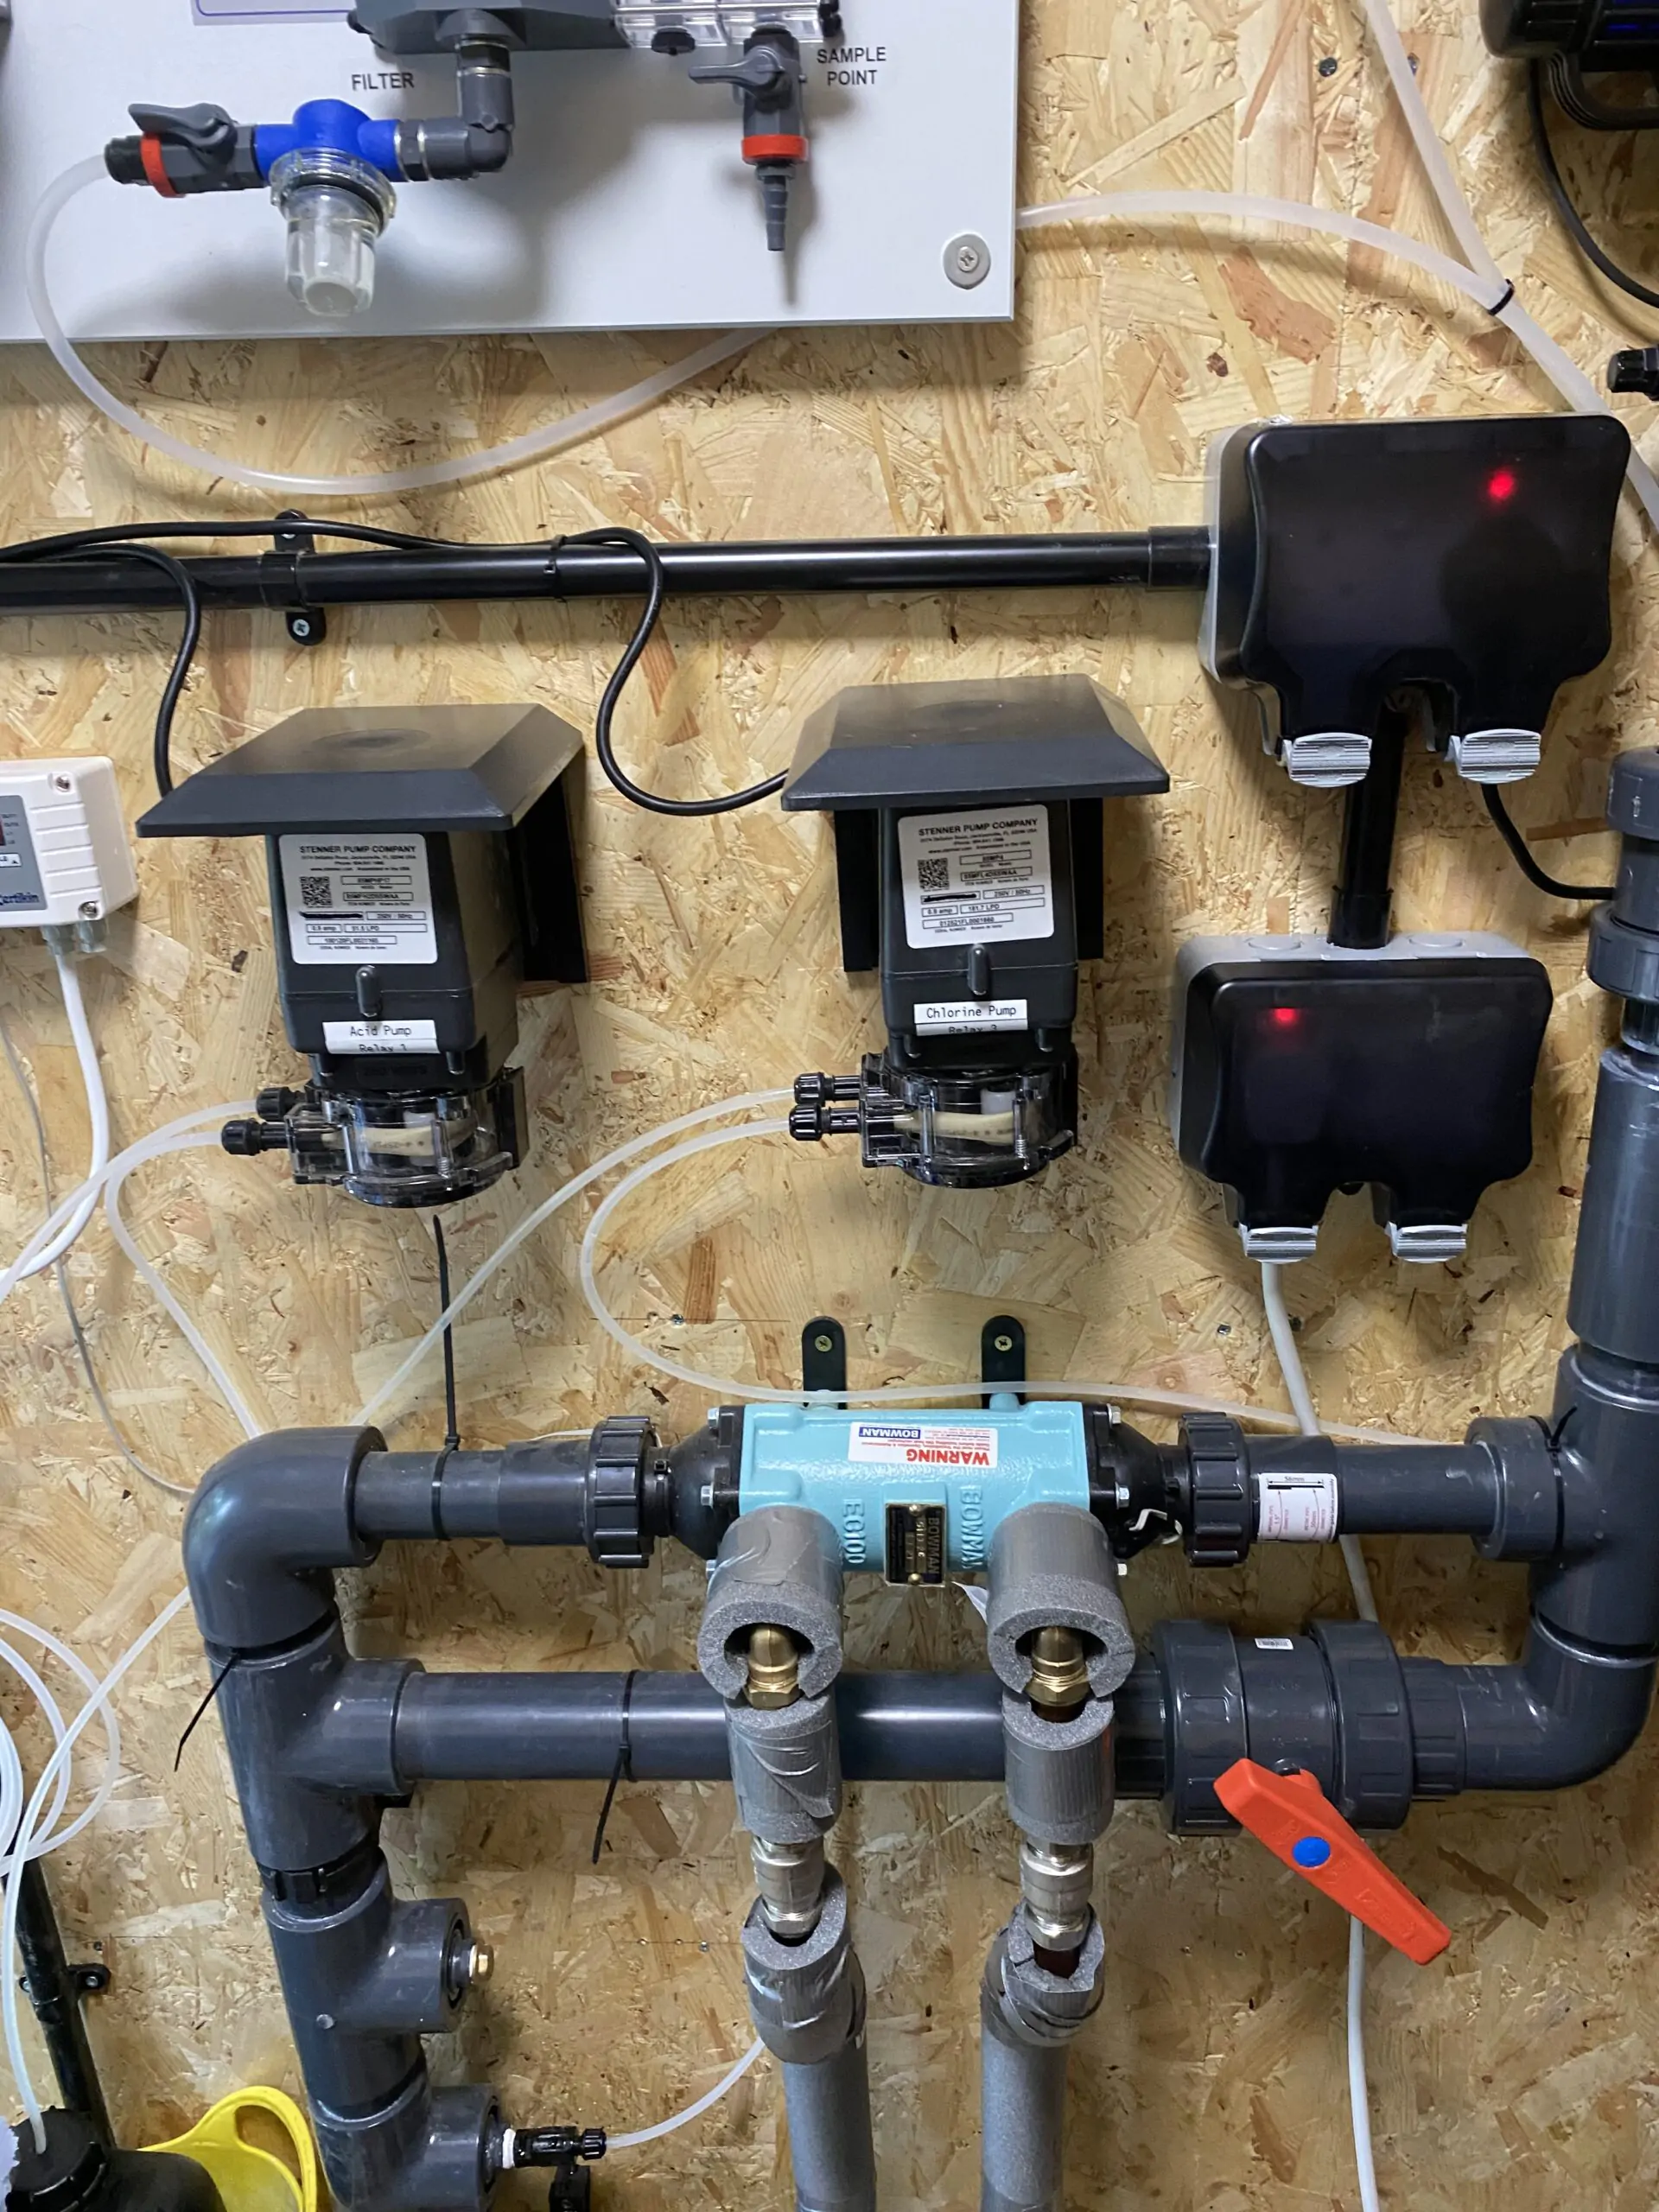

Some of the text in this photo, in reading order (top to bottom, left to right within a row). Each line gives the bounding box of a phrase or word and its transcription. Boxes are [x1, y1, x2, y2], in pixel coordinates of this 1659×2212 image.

[817, 47, 887, 63] SAMPLE
[351, 73, 415, 91] FILTER
[827, 69, 877, 86] POINT
[918, 825, 961, 836] STENNER
[963, 823, 990, 832] PUMP
[992, 818, 1038, 830] COMPANY
[300, 845, 416, 854] STENNER PUMP COMPANY
[926, 1006, 1017, 1018] Chlorine Pump
[350, 1025, 412, 1037] Acid Pump
[359, 1044, 393, 1052] Relay
[862, 1427, 919, 1438] BOWMAN
[906, 1448, 989, 1466] WARNING
[927, 1517, 941, 1574] BOWMAN
